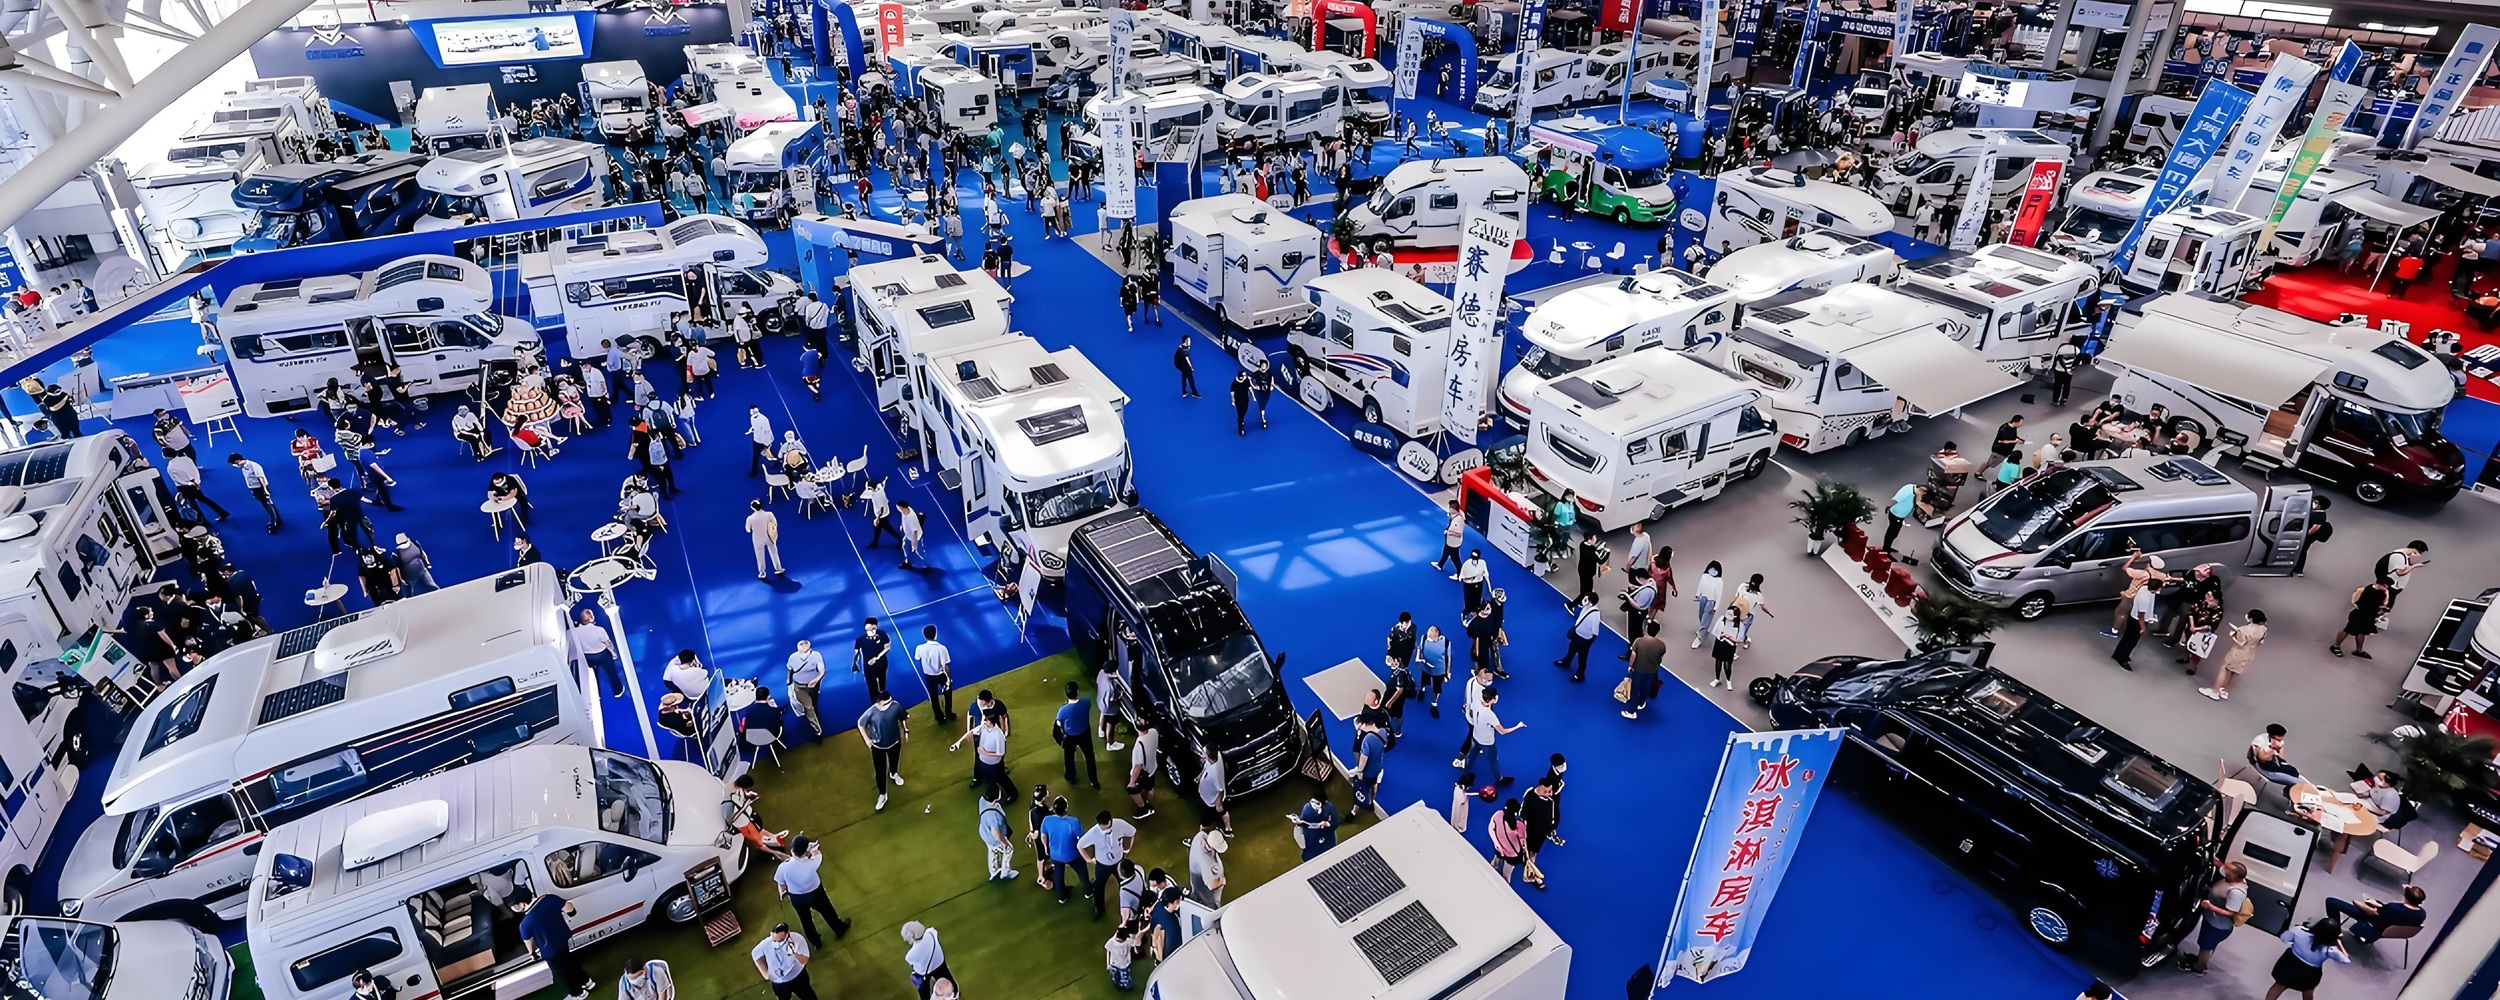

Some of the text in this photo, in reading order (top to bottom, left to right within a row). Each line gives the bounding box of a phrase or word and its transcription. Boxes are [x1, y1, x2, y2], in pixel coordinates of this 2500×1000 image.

[1446, 244, 1490, 408] 赛德房车
[1696, 753, 1799, 944] 冰淇淋房车
